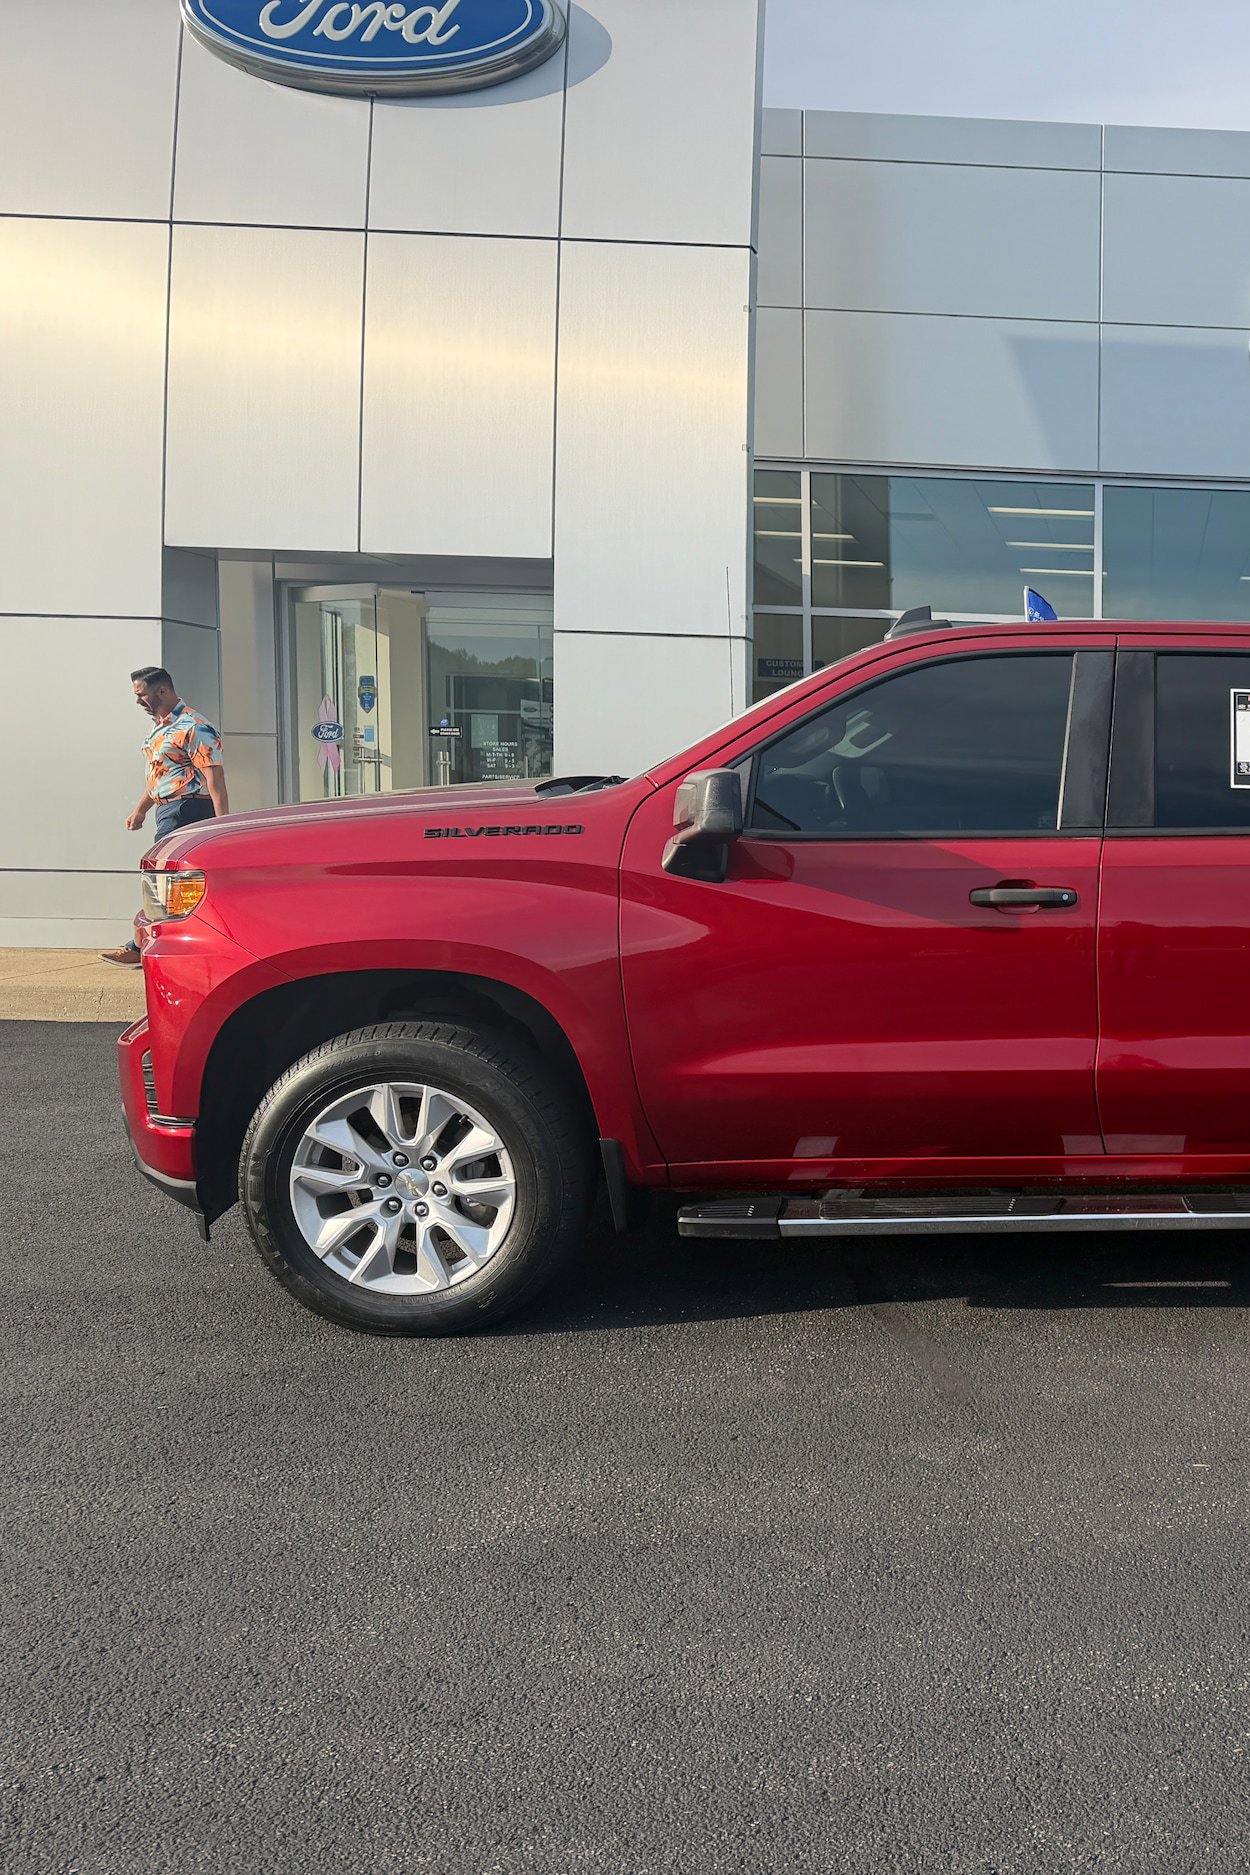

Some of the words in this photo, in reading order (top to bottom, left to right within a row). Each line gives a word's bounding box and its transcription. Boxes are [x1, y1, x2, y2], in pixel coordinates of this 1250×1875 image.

[772, 669, 804, 677] LOUNG
[317, 724, 339, 739] Ford
[424, 824, 586, 839] SILVERADO
